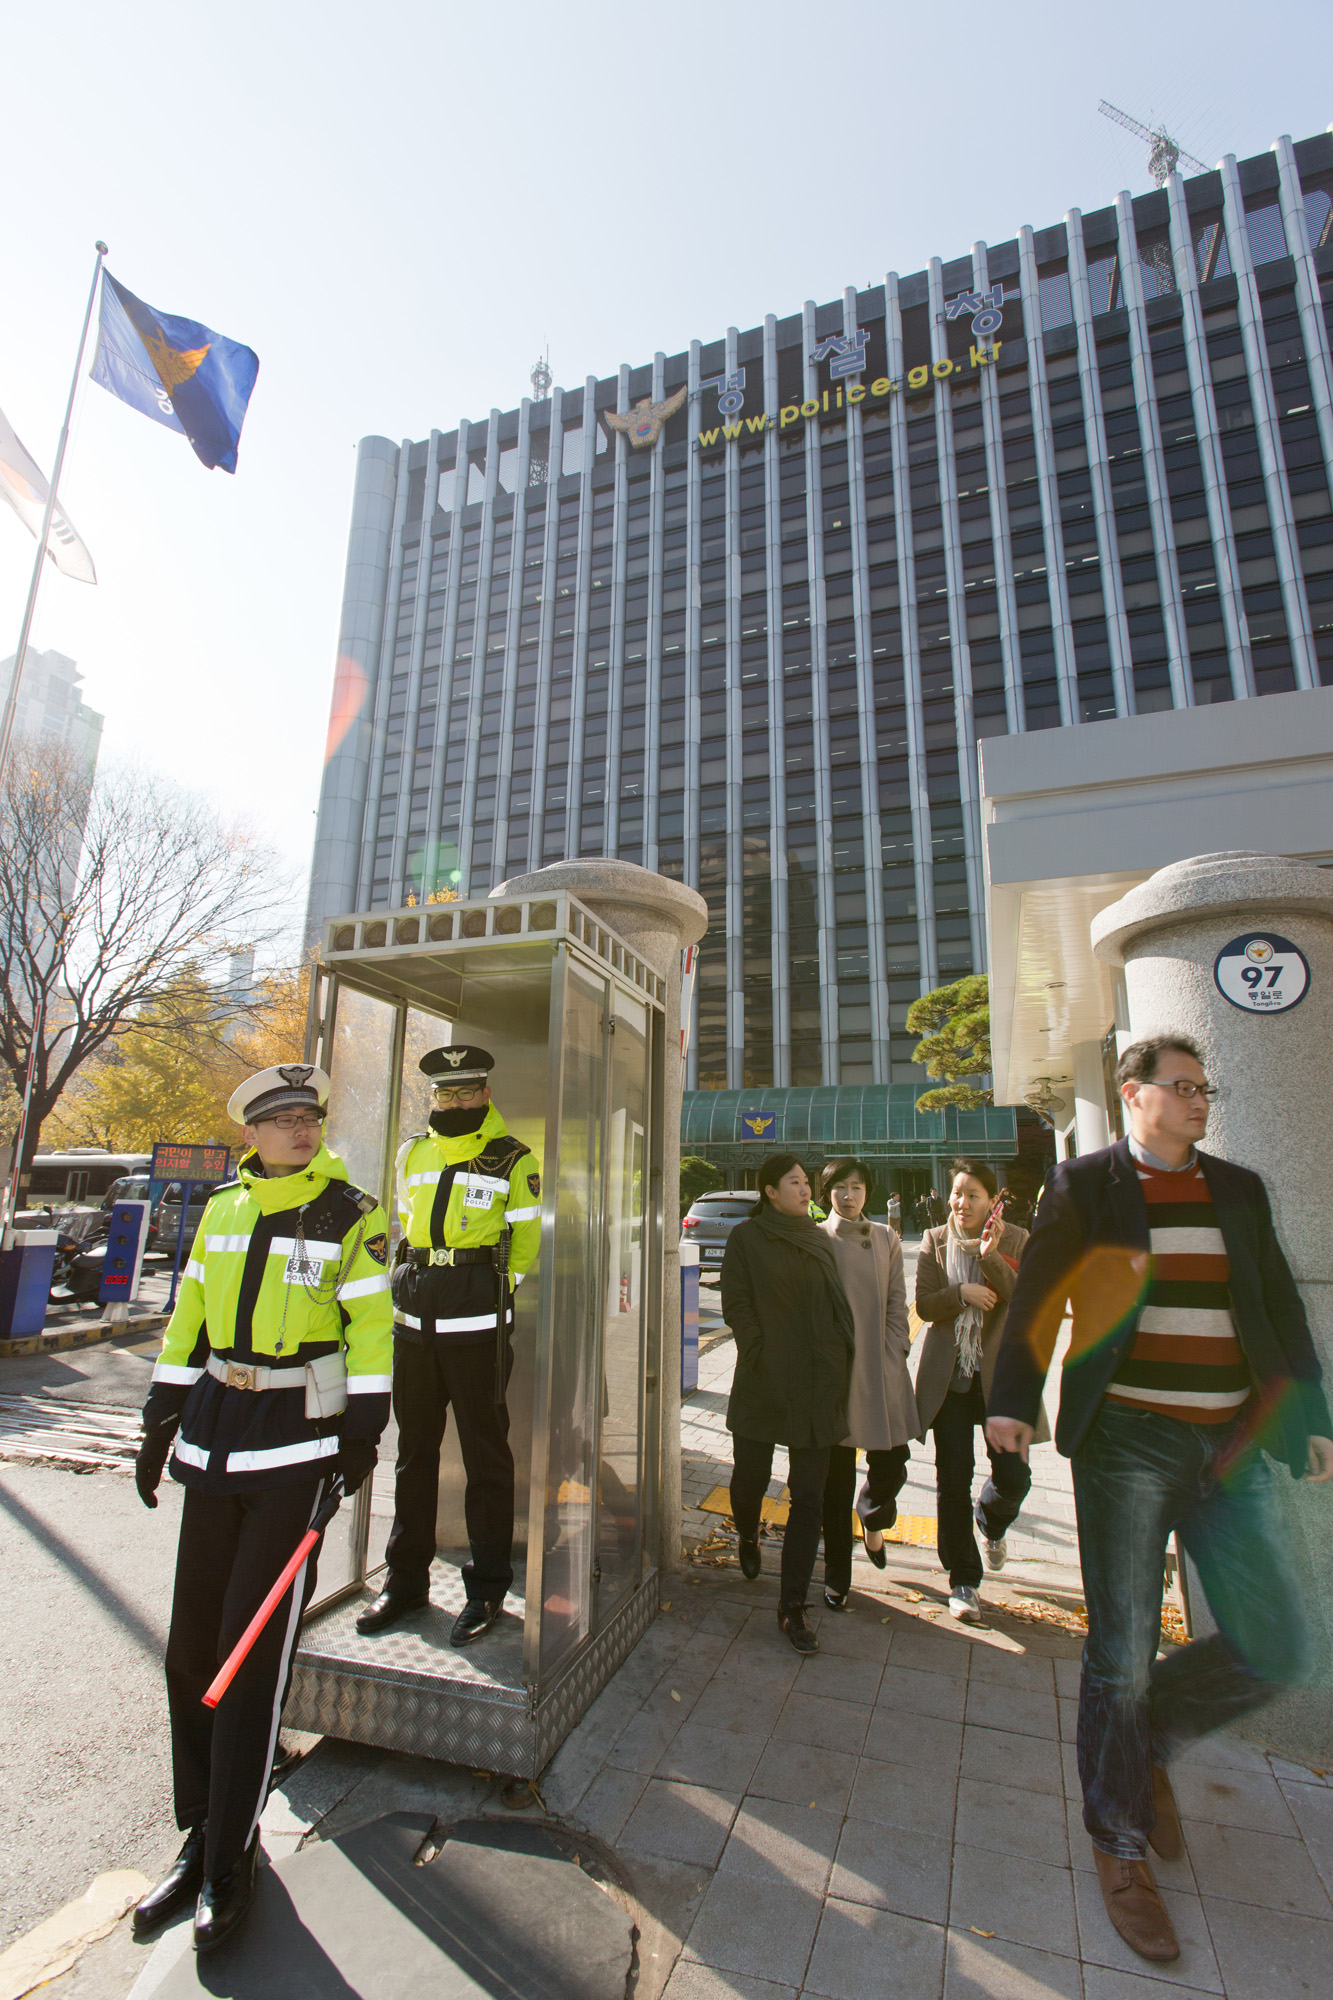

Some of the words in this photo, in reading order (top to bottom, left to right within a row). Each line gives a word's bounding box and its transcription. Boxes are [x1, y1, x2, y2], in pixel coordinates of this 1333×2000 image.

[698, 341, 1002, 448] www.police.go.kr
[1241, 966, 1284, 989] 97
[157, 1147, 192, 1158] 국민이
[204, 1149, 226, 1159] 믿고
[155, 1158, 191, 1168] 의지할
